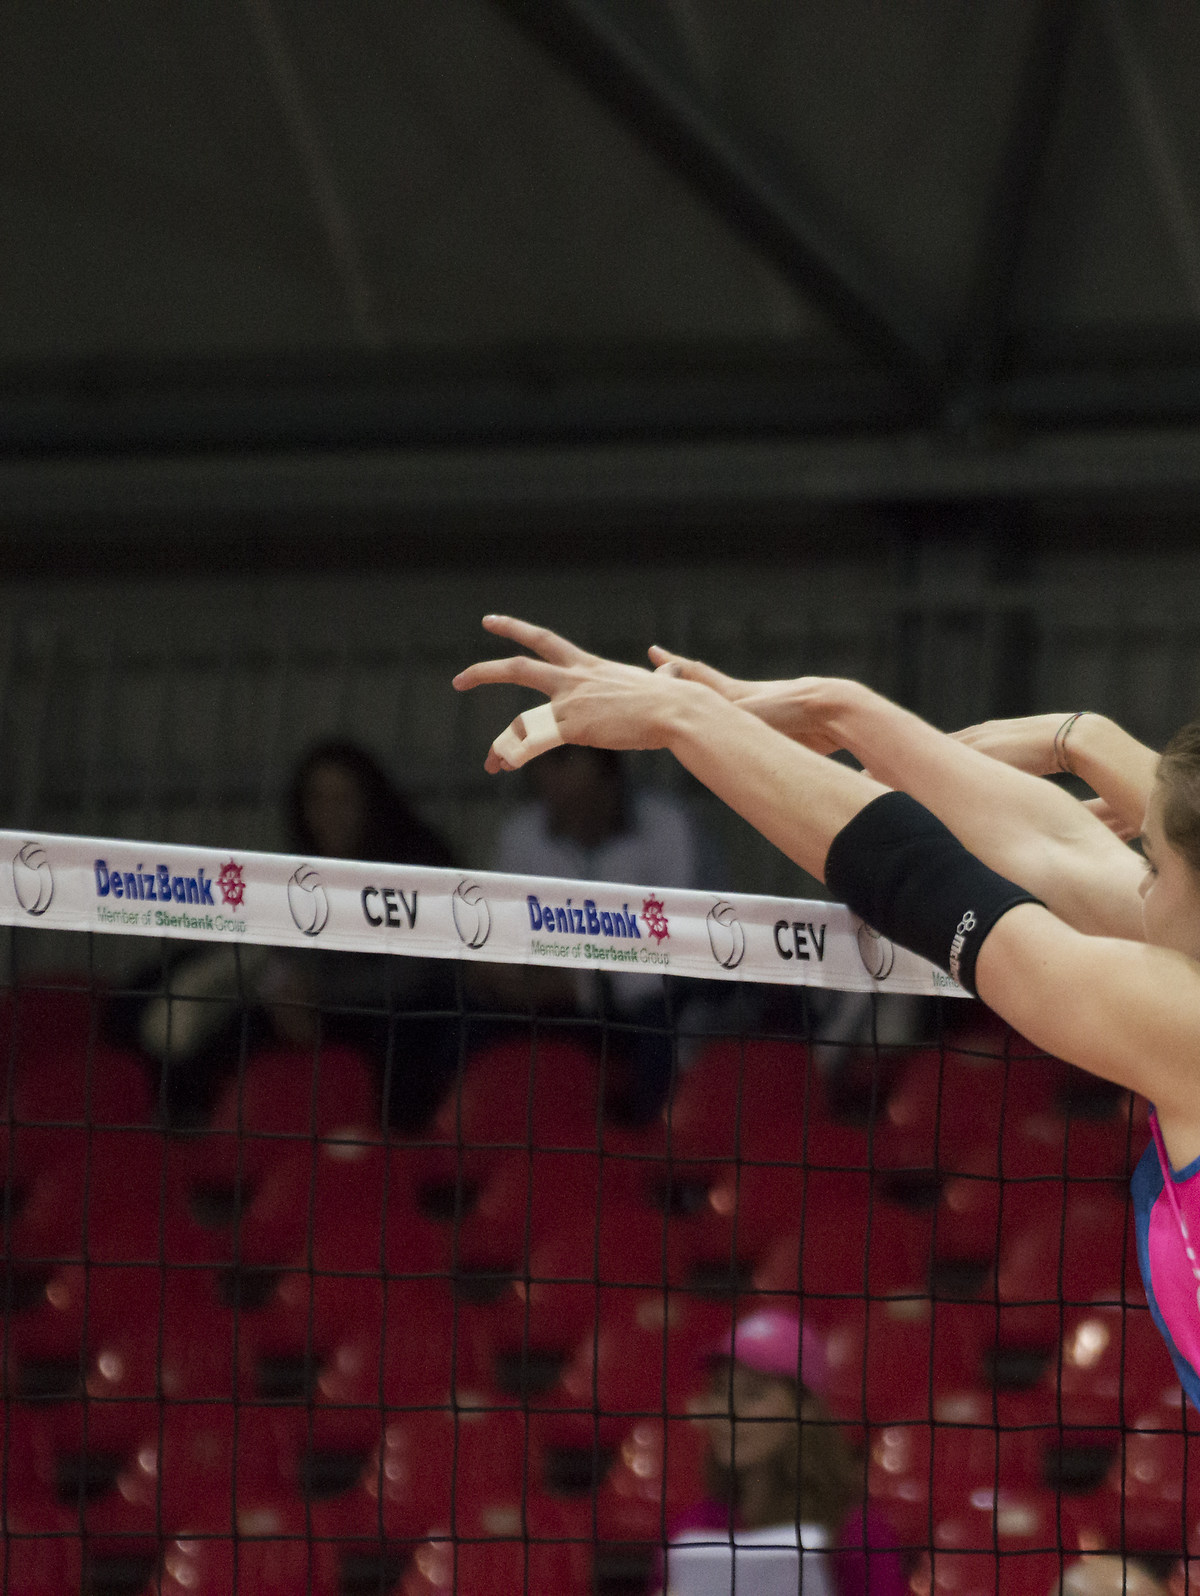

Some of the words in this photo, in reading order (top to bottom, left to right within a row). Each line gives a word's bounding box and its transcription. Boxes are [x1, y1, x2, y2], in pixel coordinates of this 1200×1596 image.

[94, 859, 215, 906] DenizBank
[97, 906, 139, 925] Member
[141, 910, 151, 925] of
[154, 911, 214, 931] Sberbank
[214, 914, 246, 933] Group
[360, 885, 419, 931] CEV
[526, 895, 641, 939] DenizBank
[531, 939, 570, 957] Member
[571, 943, 582, 958] of
[583, 943, 639, 963] Sberbank
[639, 948, 671, 967] Group
[773, 919, 828, 963] CEV
